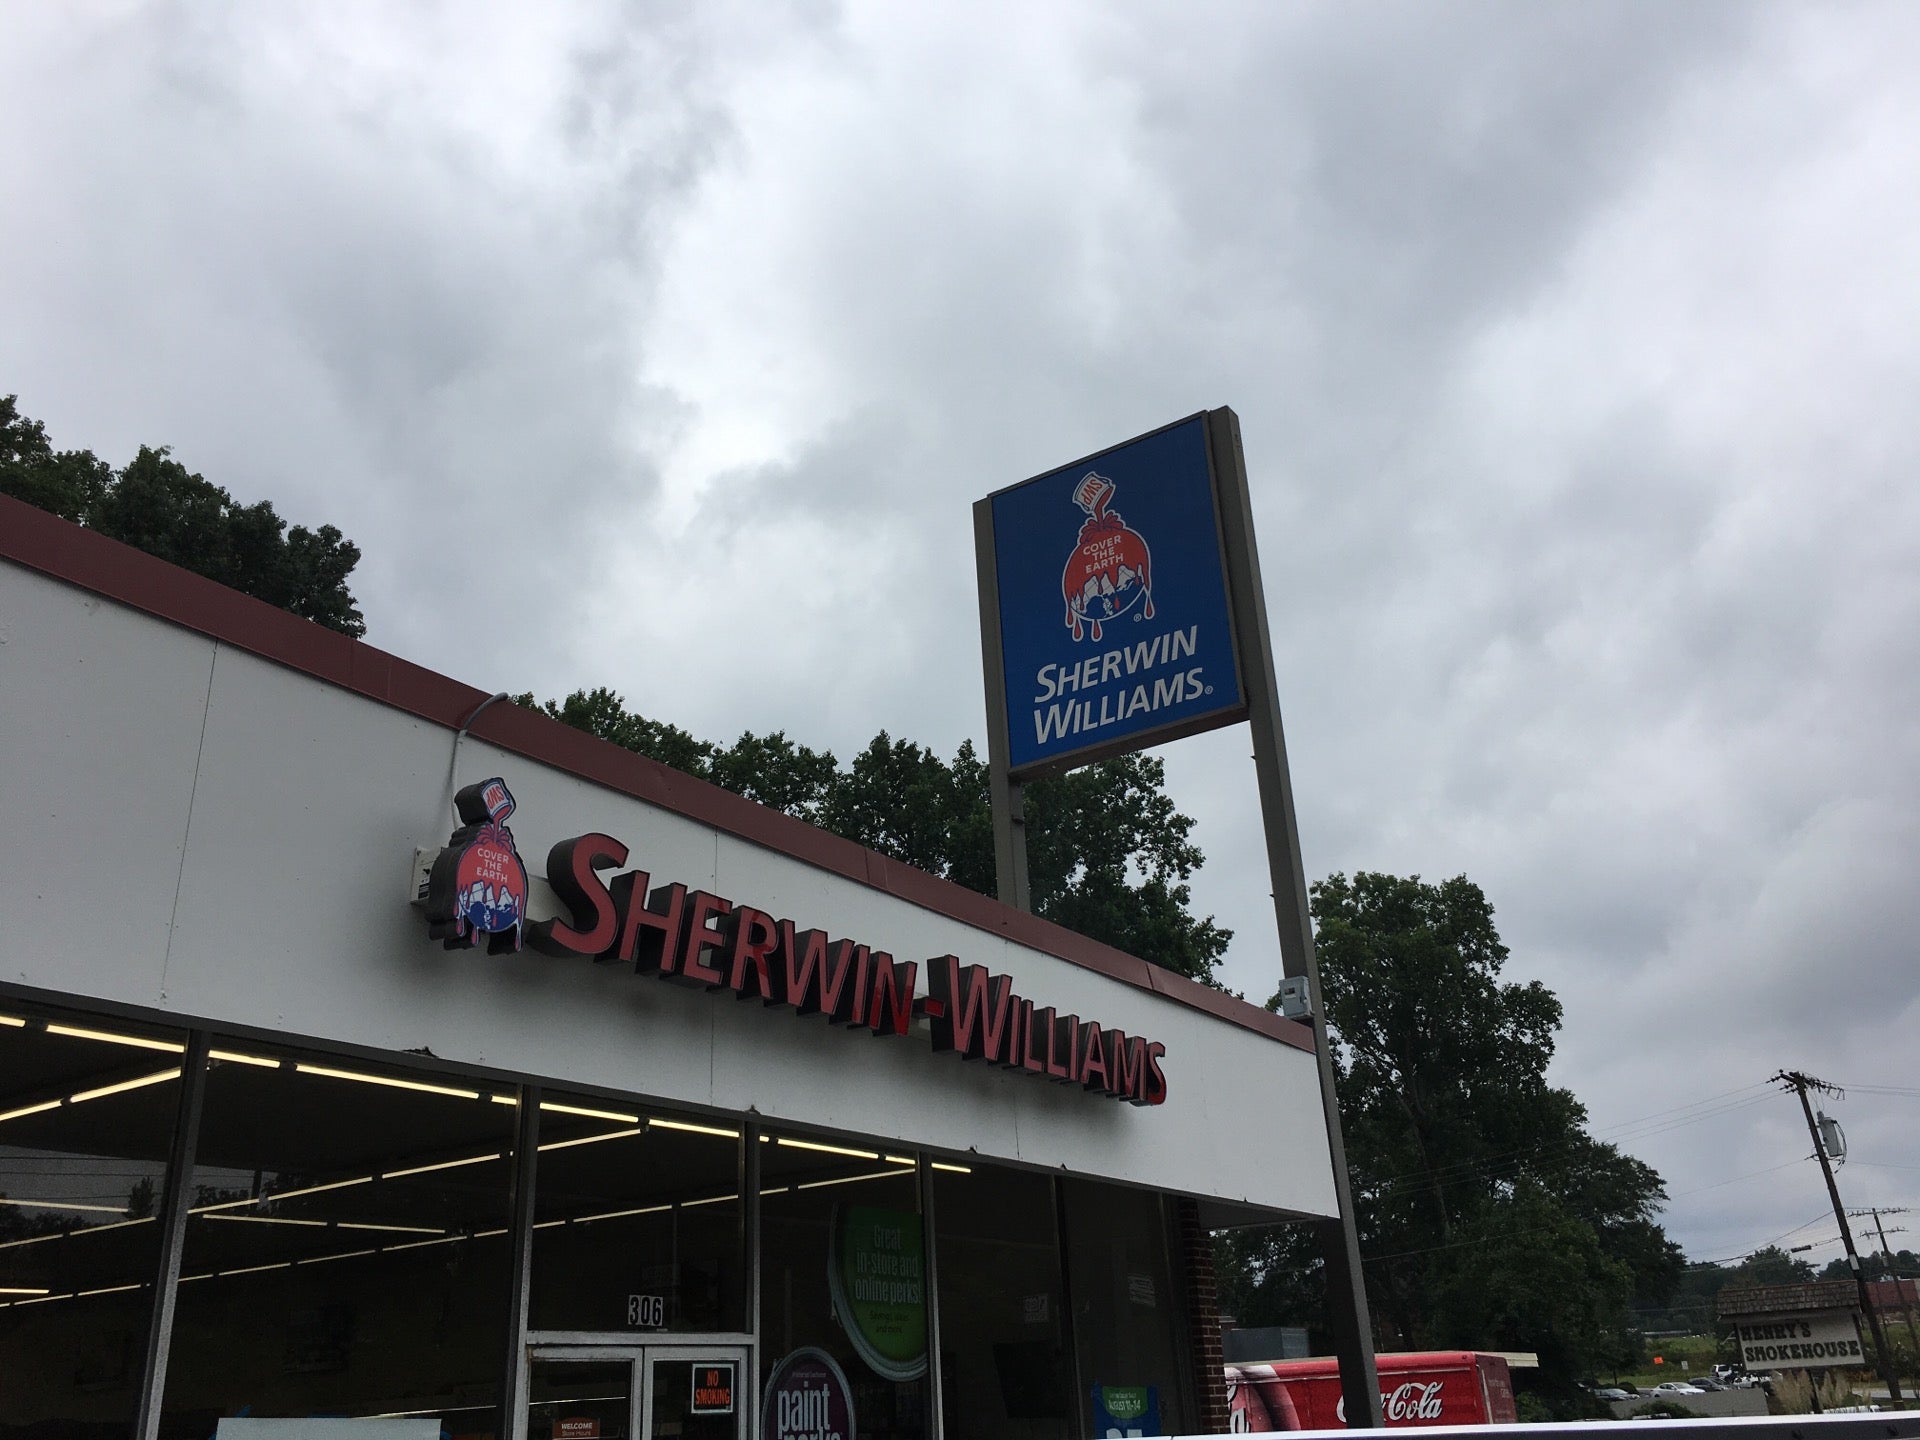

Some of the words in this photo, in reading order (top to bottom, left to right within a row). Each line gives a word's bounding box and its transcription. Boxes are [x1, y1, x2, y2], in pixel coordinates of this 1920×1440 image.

[1081, 479, 1103, 506] SWP
[1083, 535, 1122, 556] COVER
[1092, 546, 1115, 562] THE
[1085, 553, 1124, 574] EARTH
[1034, 625, 1198, 703] SHERWIN
[1034, 668, 1205, 744] WILLIAMS
[477, 847, 510, 865] COVER
[484, 859, 503, 871] THE
[476, 868, 508, 884] EARTH
[874, 1225, 902, 1250] Great
[857, 1249, 898, 1276] in-store
[899, 1255, 919, 1277] and
[855, 1276, 889, 1301] online
[630, 1296, 662, 1326] 306
[1740, 1321, 1811, 1342] HENRY'S
[1745, 1340, 1860, 1362] SMOKEHOUSE
[706, 1369, 720, 1387] NO
[695, 1387, 731, 1405] SMOKING
[777, 1380, 831, 1439] paint
[561, 1422, 593, 1430] WELCOME
